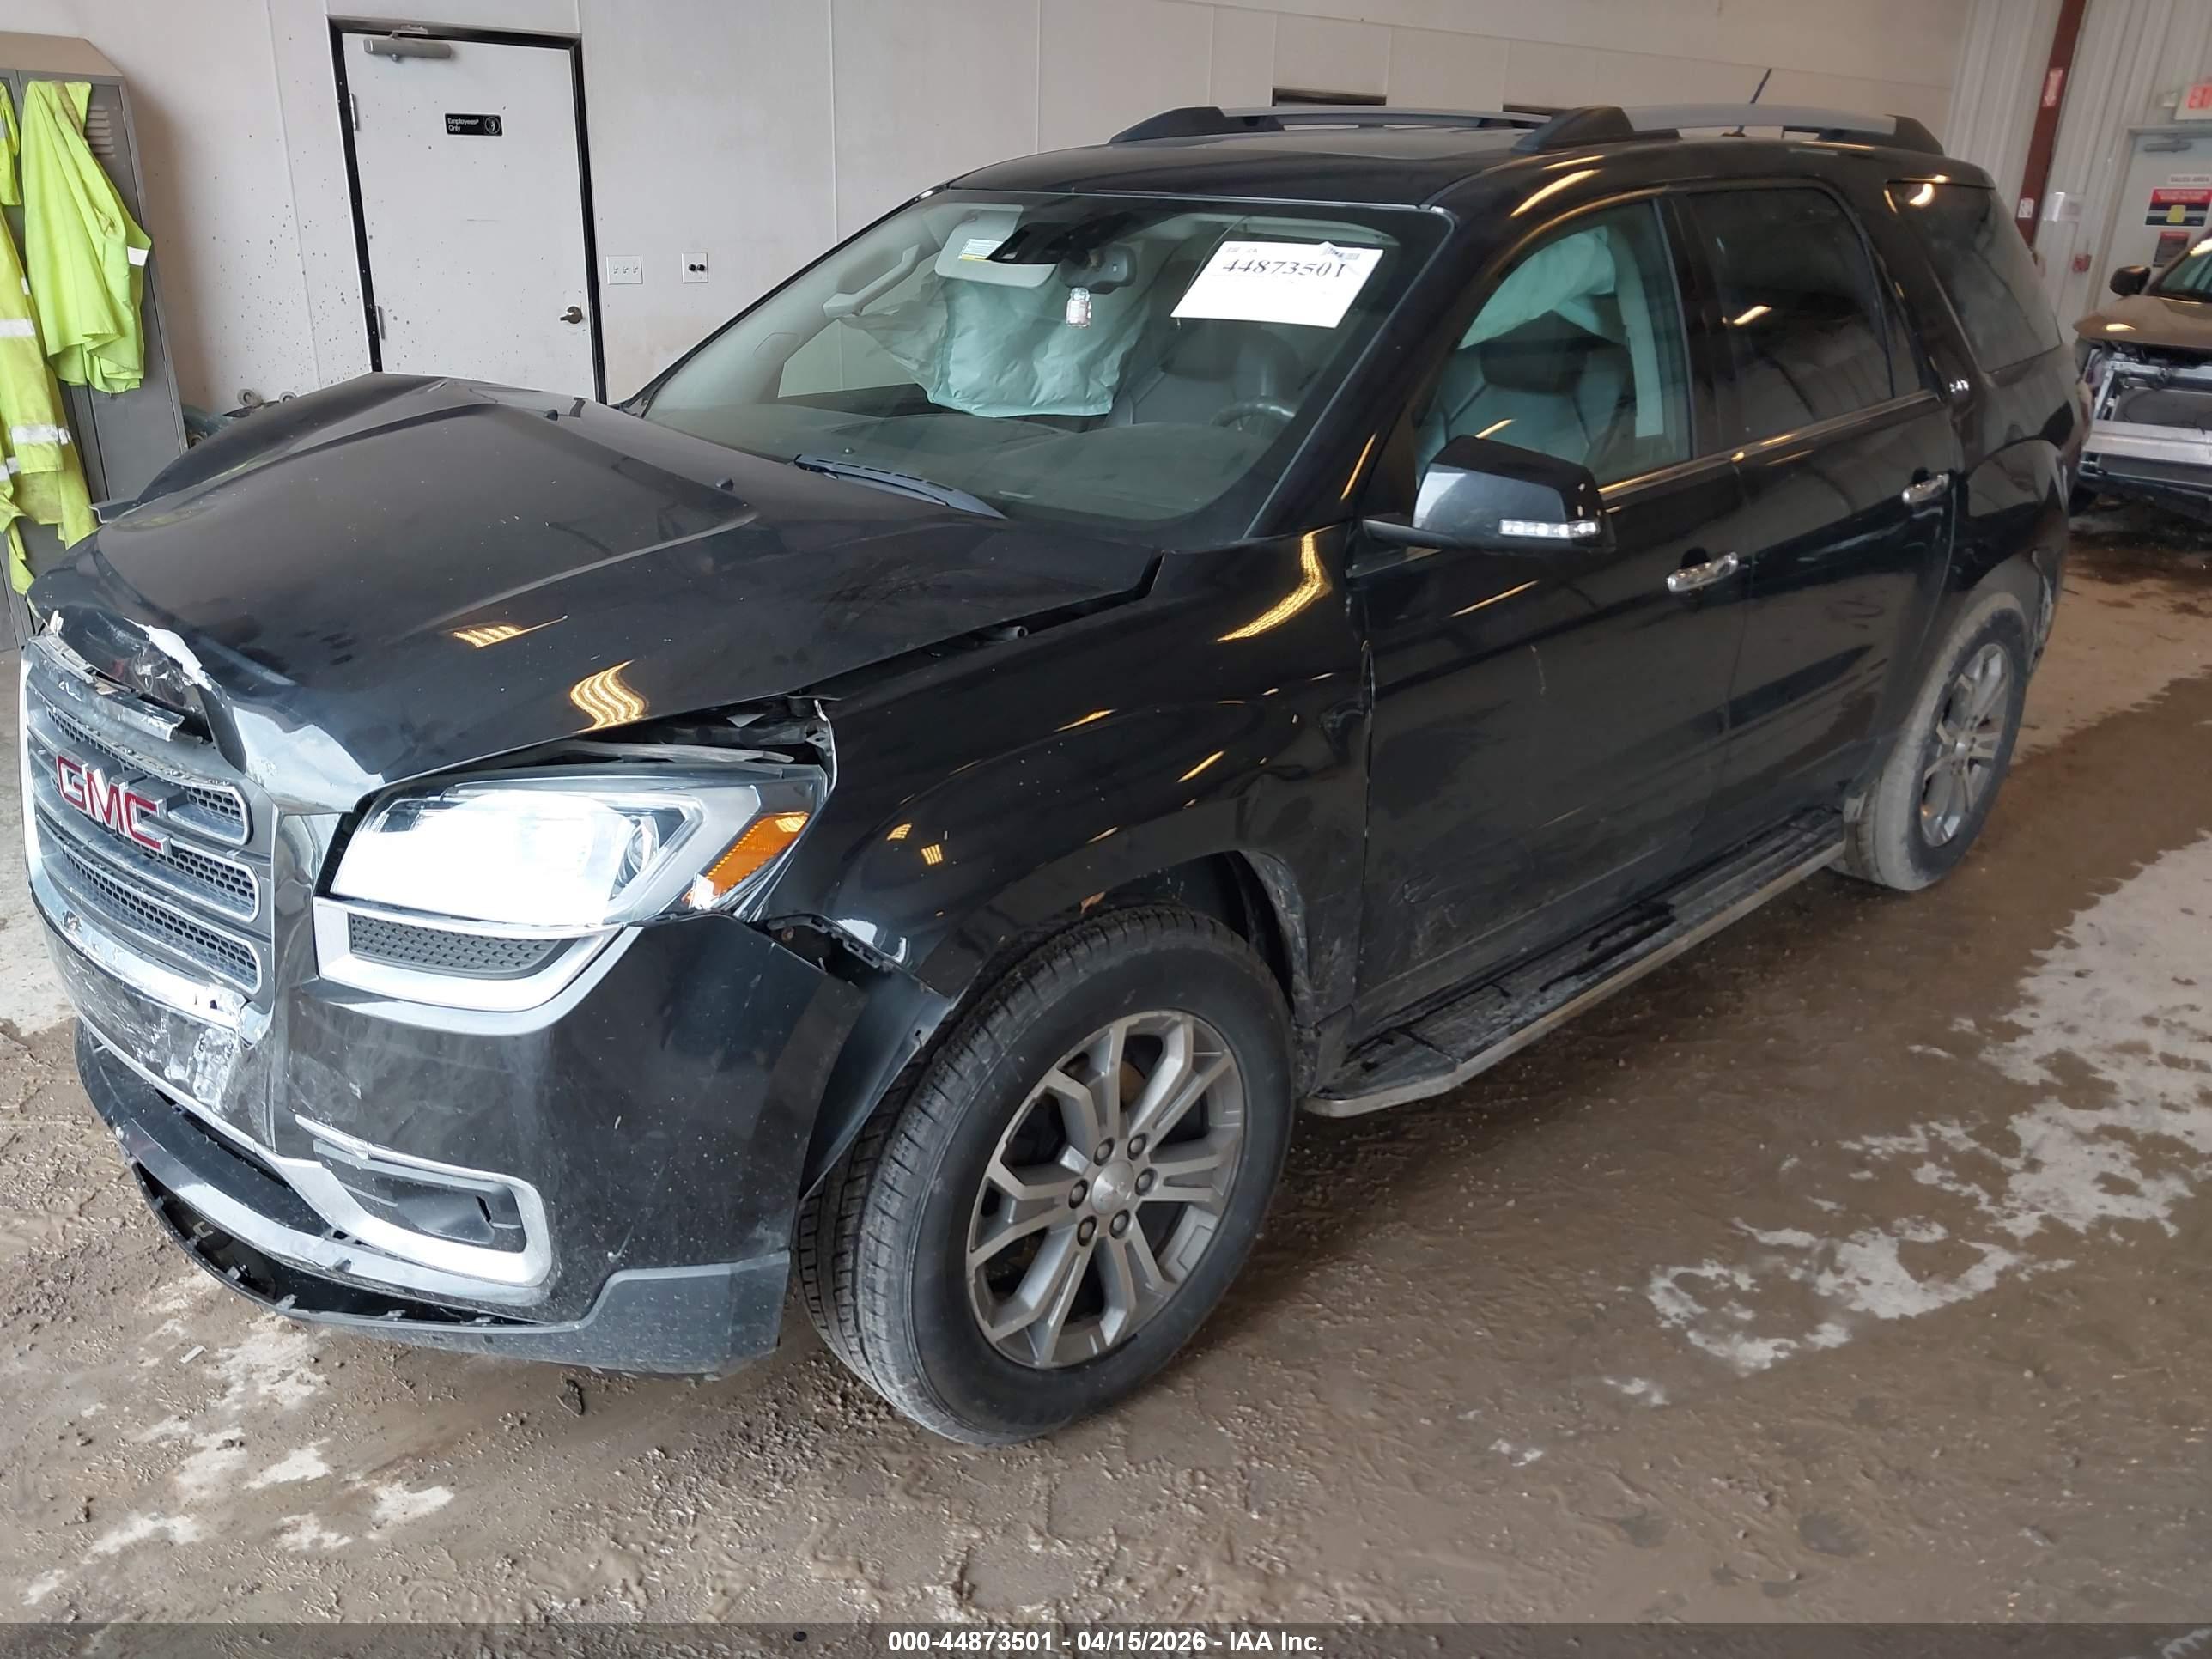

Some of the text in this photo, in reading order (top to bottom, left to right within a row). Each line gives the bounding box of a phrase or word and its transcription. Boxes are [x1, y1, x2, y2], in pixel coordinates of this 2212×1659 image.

[448, 124, 461, 133] Only
[1222, 259, 1346, 278] 44873501
[56, 754, 171, 855] GMC
